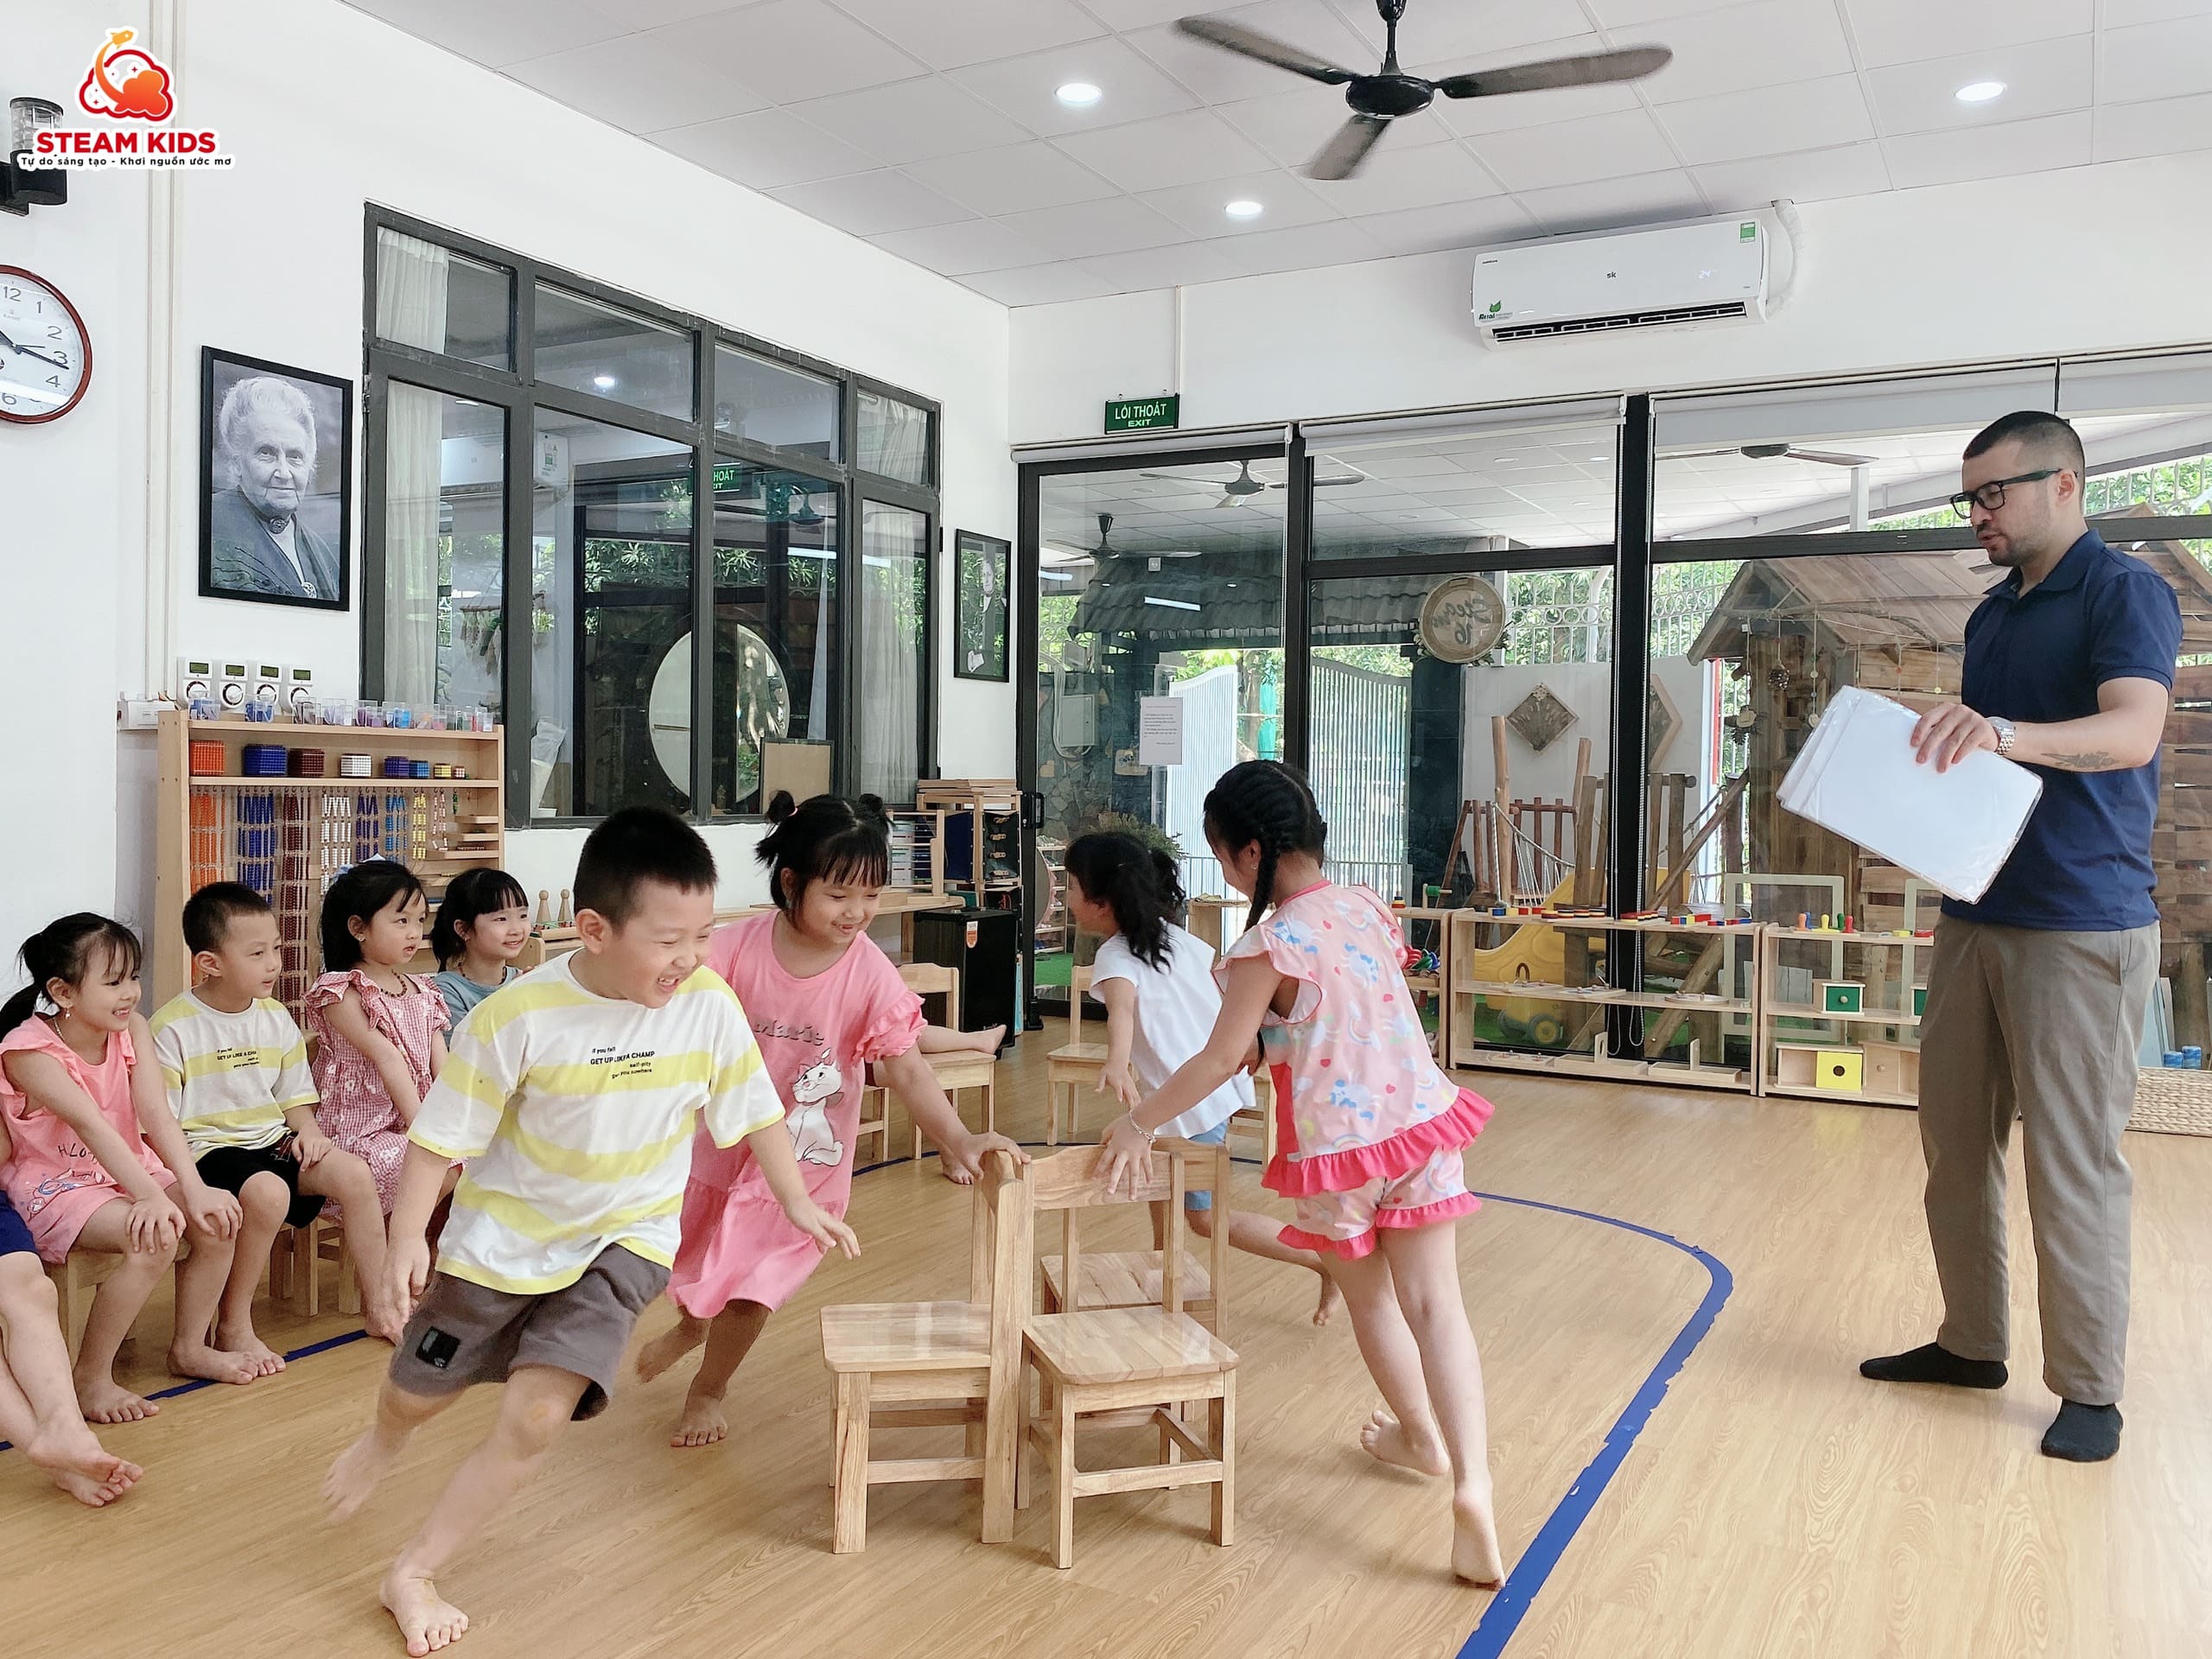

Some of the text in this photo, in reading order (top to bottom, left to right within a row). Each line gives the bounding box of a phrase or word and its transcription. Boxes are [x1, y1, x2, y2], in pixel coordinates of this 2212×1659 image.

[3, 285, 22, 302] 12
[36, 301, 42, 314] 1
[47, 325, 63, 340] 2
[53, 351, 68, 365] 3
[45, 374, 61, 388] 4
[2, 392, 17, 405] 6
[1133, 401, 1167, 418] THOÁT
[1128, 419, 1152, 428] EXIT
[713, 467, 734, 482] HOÁT
[590, 1057, 604, 1065] GET
[631, 1051, 656, 1059] CHAMP
